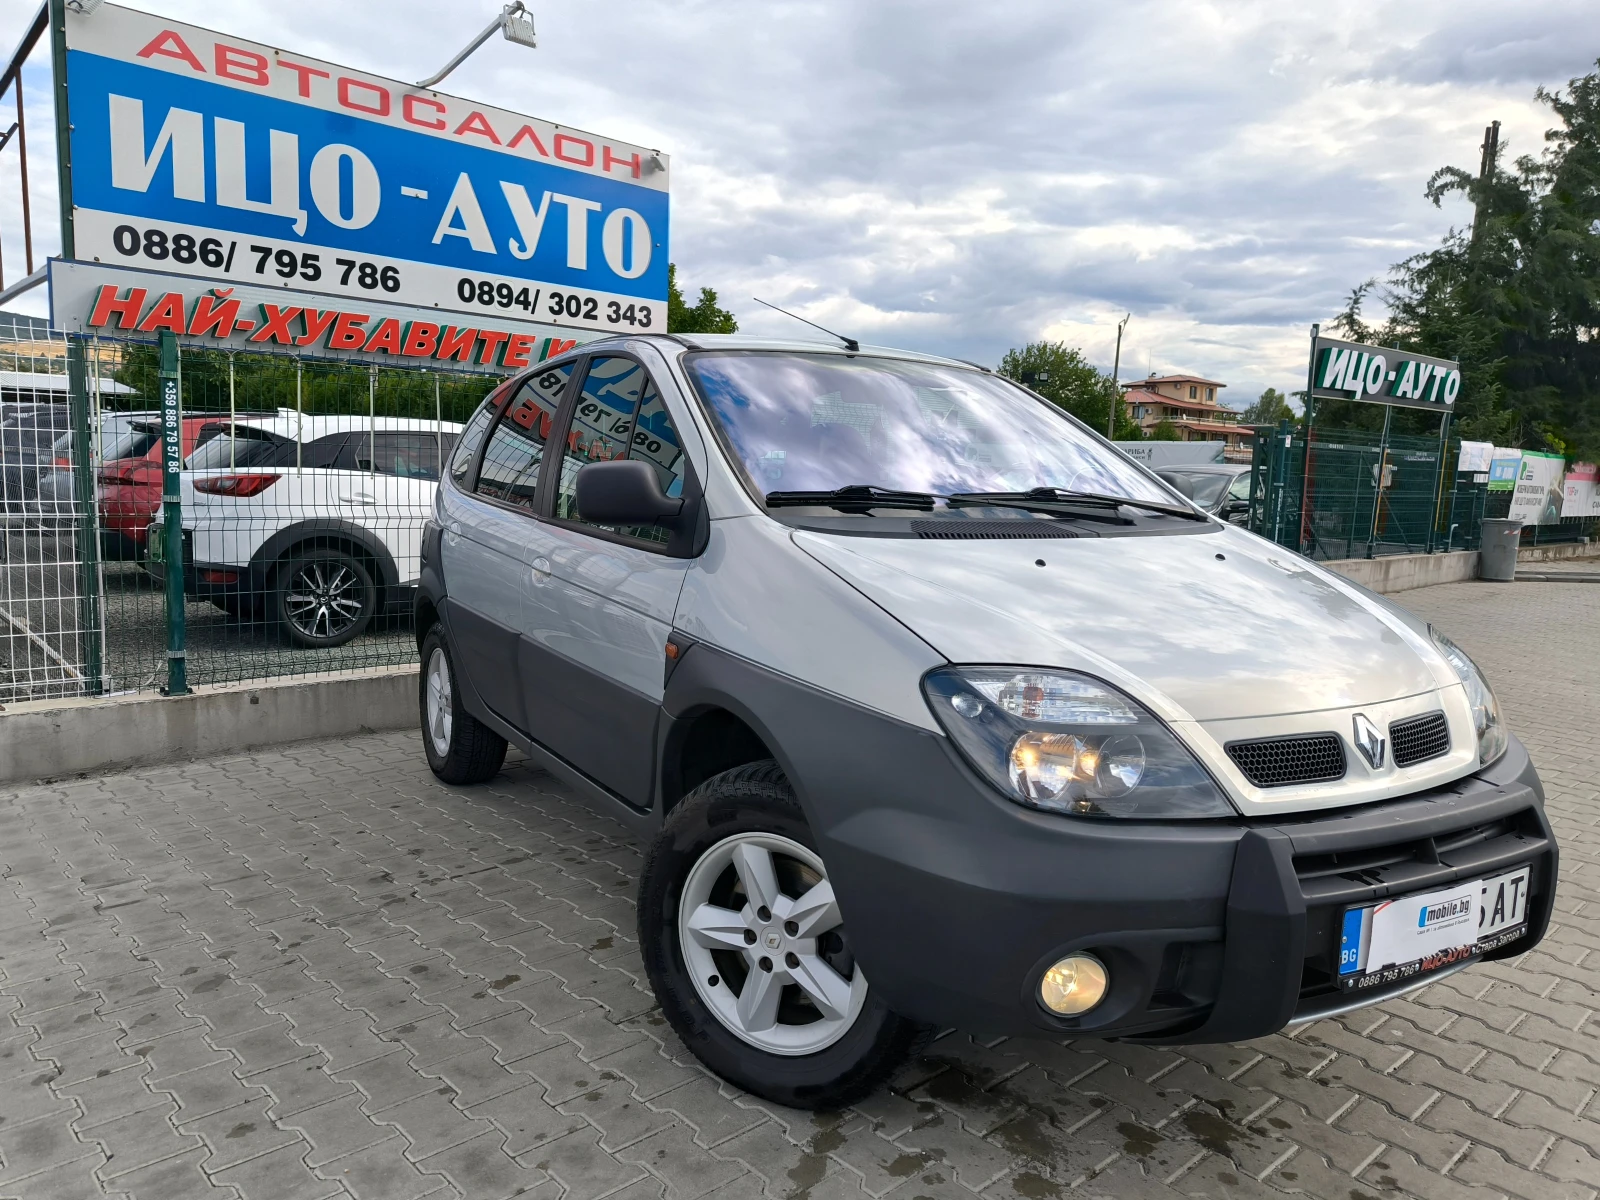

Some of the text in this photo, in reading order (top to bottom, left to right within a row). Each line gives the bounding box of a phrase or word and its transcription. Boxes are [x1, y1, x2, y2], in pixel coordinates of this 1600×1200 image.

[136, 29, 641, 179] АВТОСАЛОН
[113, 225, 401, 293] 0886/ 795 786
[89, 284, 536, 368] НАЙ-ХУБАВИТЕ
[457, 277, 652, 328] 0894/ 302 343
[1321, 346, 1461, 405] ИЦО-АУТО
[165, 381, 180, 473] +359 886 79 57 86
[1426, 899, 1470, 922] mobile.bg
[1341, 948, 1357, 964] BG
[1475, 929, 1520, 954] Стара Загора
[1358, 964, 1415, 988] 0886 795 786
